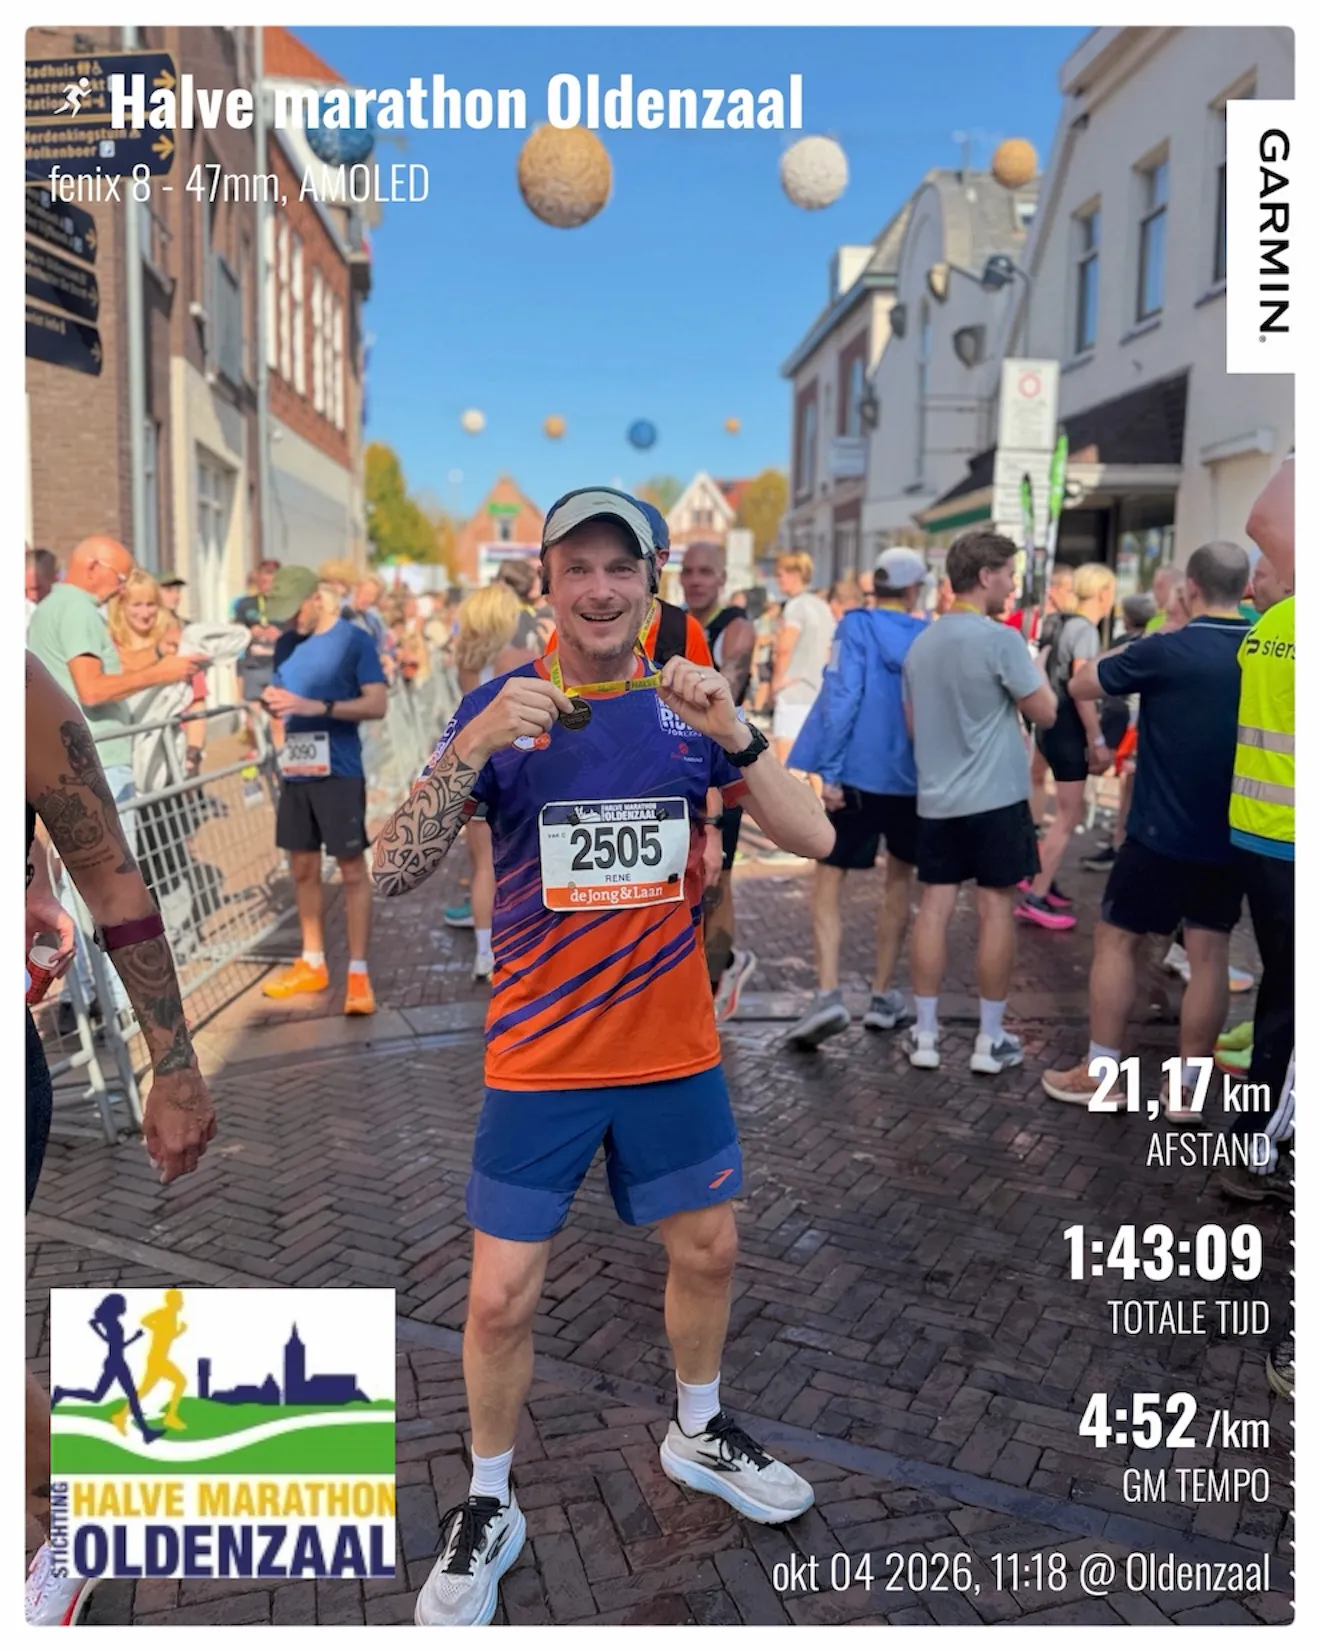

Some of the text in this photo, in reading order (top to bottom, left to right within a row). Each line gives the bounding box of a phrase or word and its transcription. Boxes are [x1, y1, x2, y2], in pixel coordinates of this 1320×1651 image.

[26, 63, 75, 78] tadhuis
[604, 809, 656, 822] OLDENZAAL
[570, 825, 662, 871] 2505
